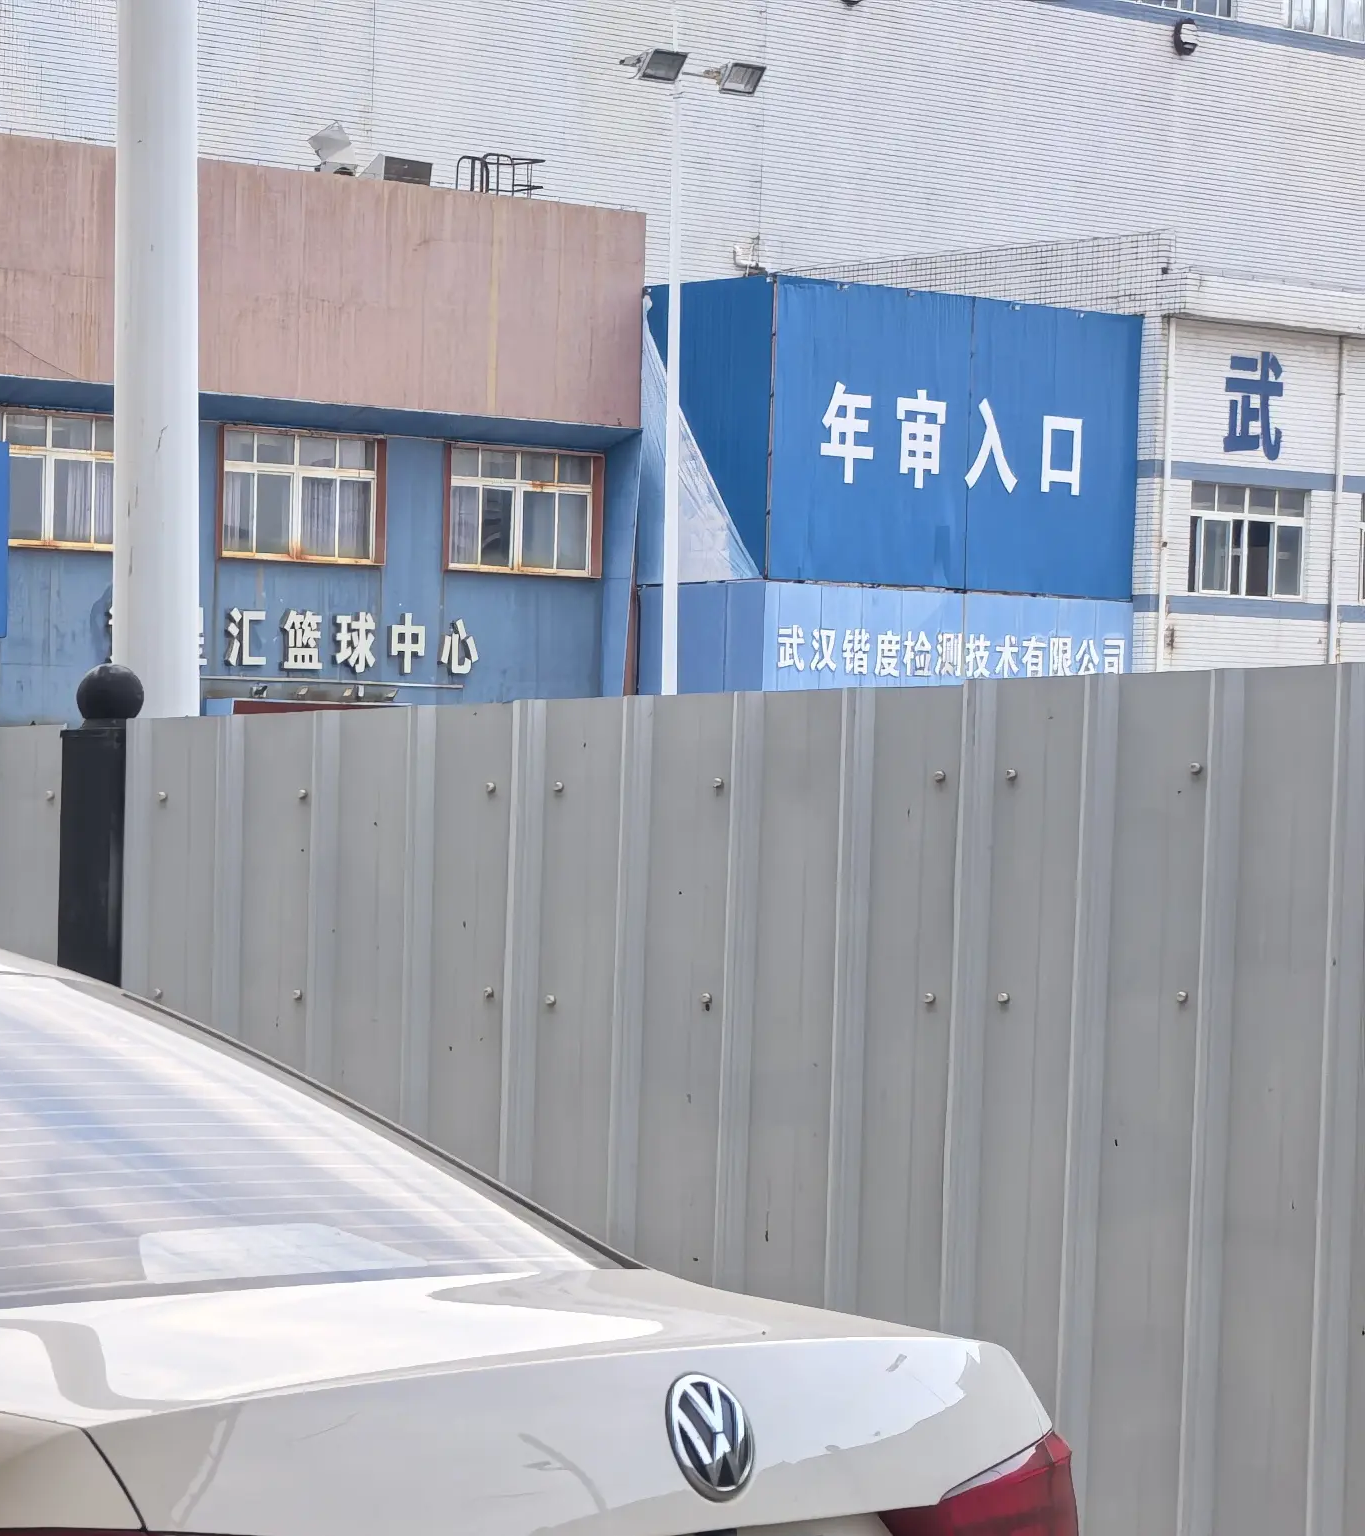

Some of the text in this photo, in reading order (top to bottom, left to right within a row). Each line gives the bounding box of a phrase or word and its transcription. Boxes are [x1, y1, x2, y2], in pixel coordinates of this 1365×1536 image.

[820, 380, 1084, 497] 年审入口
[1223, 351, 1283, 461] 武
[108, 606, 479, 675] 汇篮球中心
[777, 624, 1126, 678] 武汉锴度检测技术有限公司
